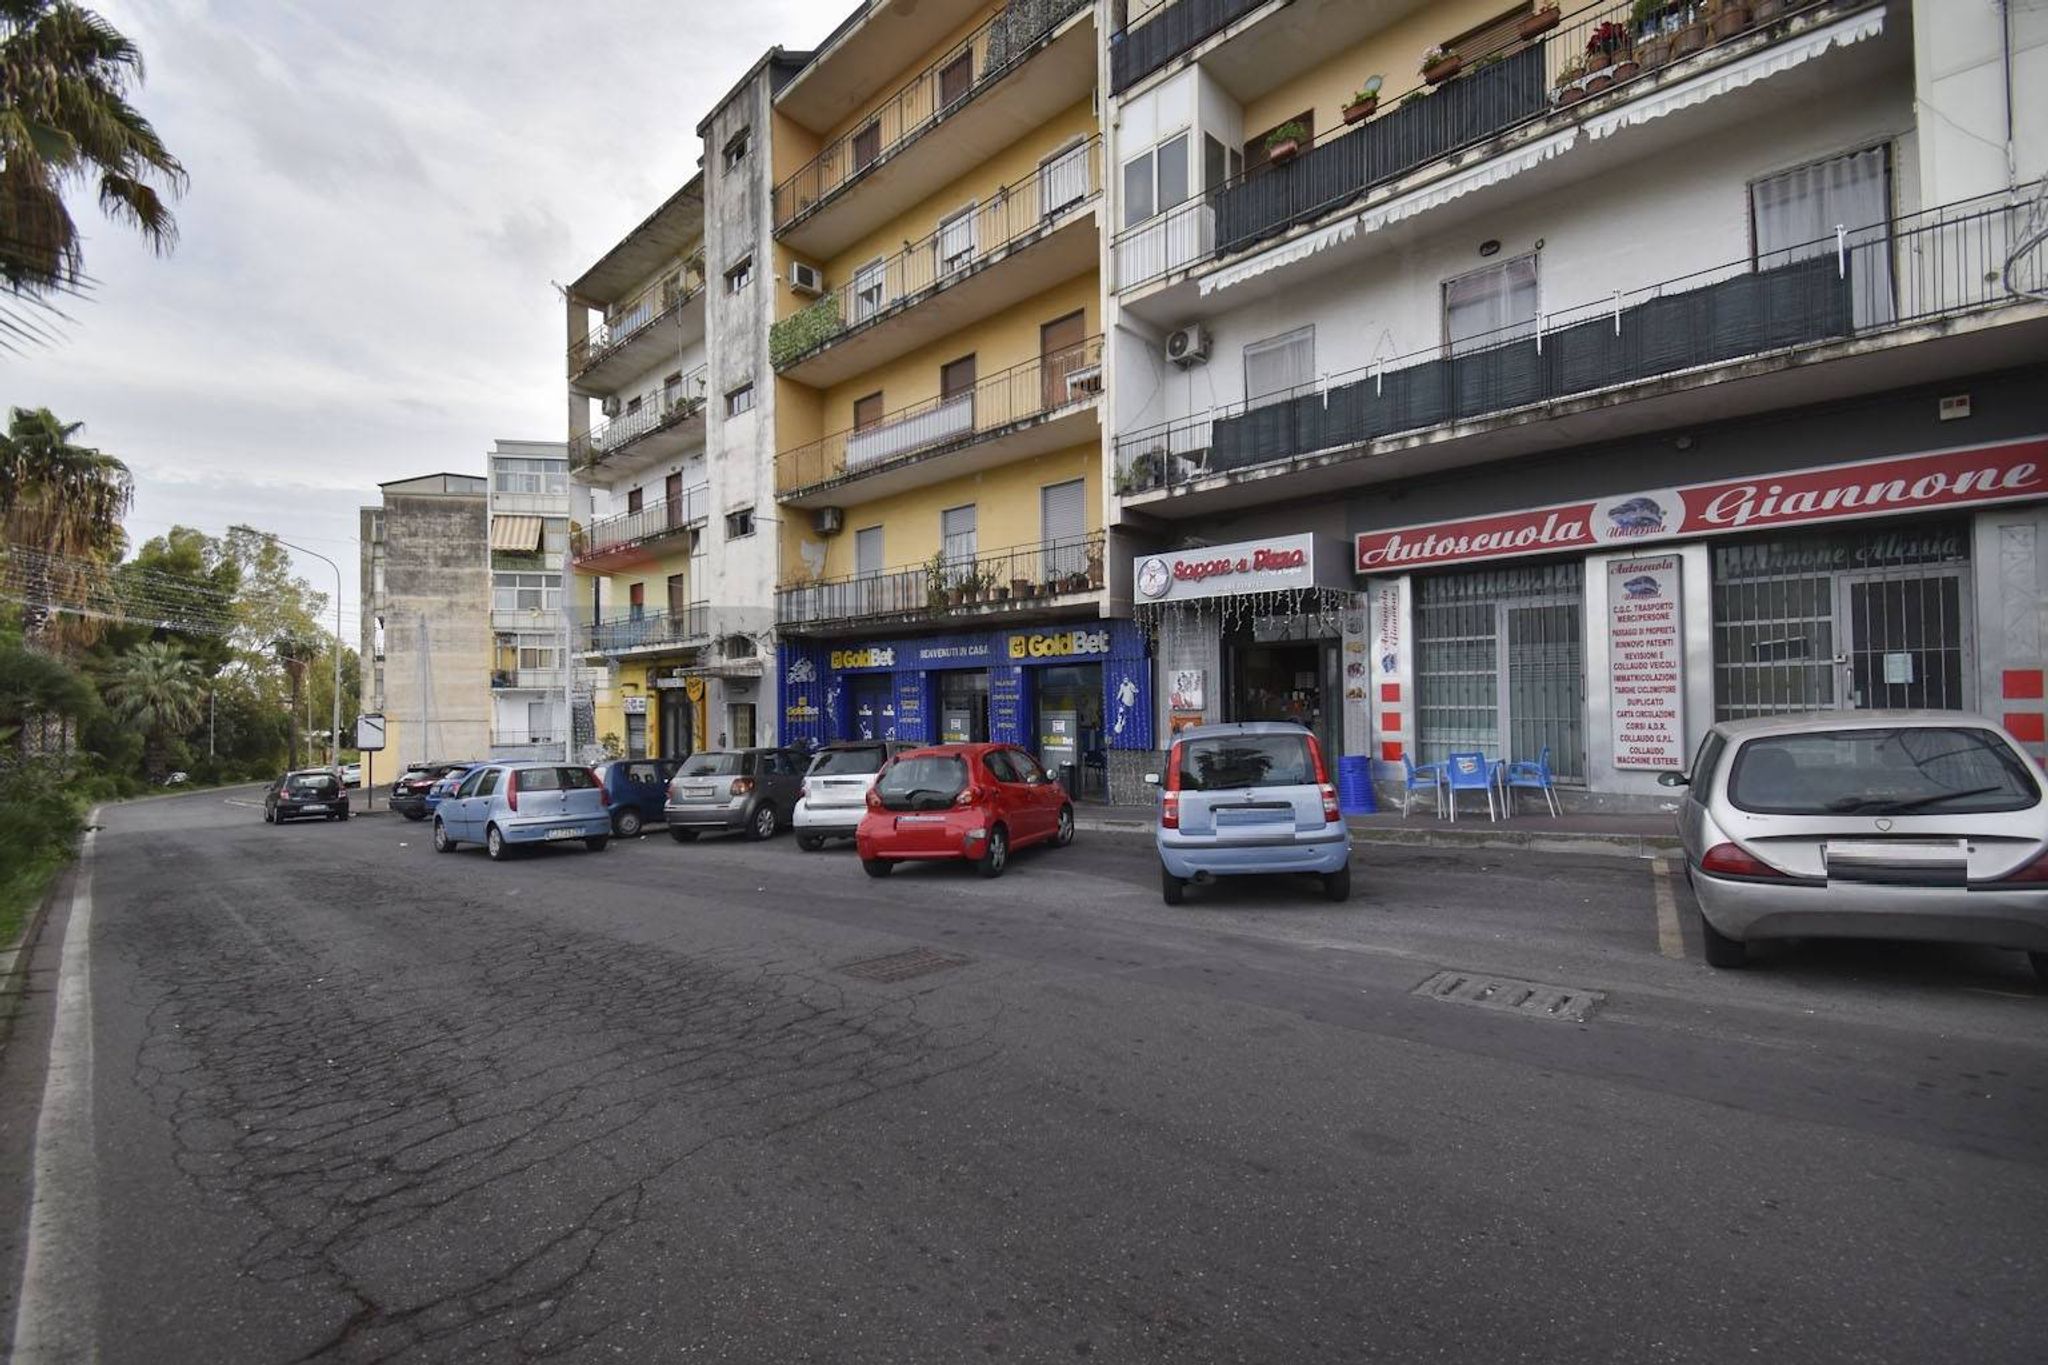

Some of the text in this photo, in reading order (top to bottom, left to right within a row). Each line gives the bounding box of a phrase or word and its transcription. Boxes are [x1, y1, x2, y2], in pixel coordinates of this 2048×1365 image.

[1698, 462, 2042, 526] Giannone
[1362, 513, 1588, 566] Autoscuola
[1173, 558, 1234, 583] Sapore
[1253, 548, 1307, 572] Pizza
[1610, 559, 1674, 575] Autoscuola
[1634, 602, 1673, 612] TRASPORTO
[1028, 631, 1110, 657] GoldBet
[1646, 638, 1673, 648] PATENTI
[842, 647, 896, 668] GoldBet
[1624, 652, 1658, 660] REVISIONI
[1613, 661, 1676, 670] COLLAUDO VEICOLI
[1627, 698, 1664, 706] DUPLICATO
[1625, 722, 1646, 730] CORSI
[1620, 734, 1655, 743] COLLAUDO
[1629, 747, 1665, 755] COLLAUDO
[1616, 756, 1679, 766] MACCHINE ESTERE
